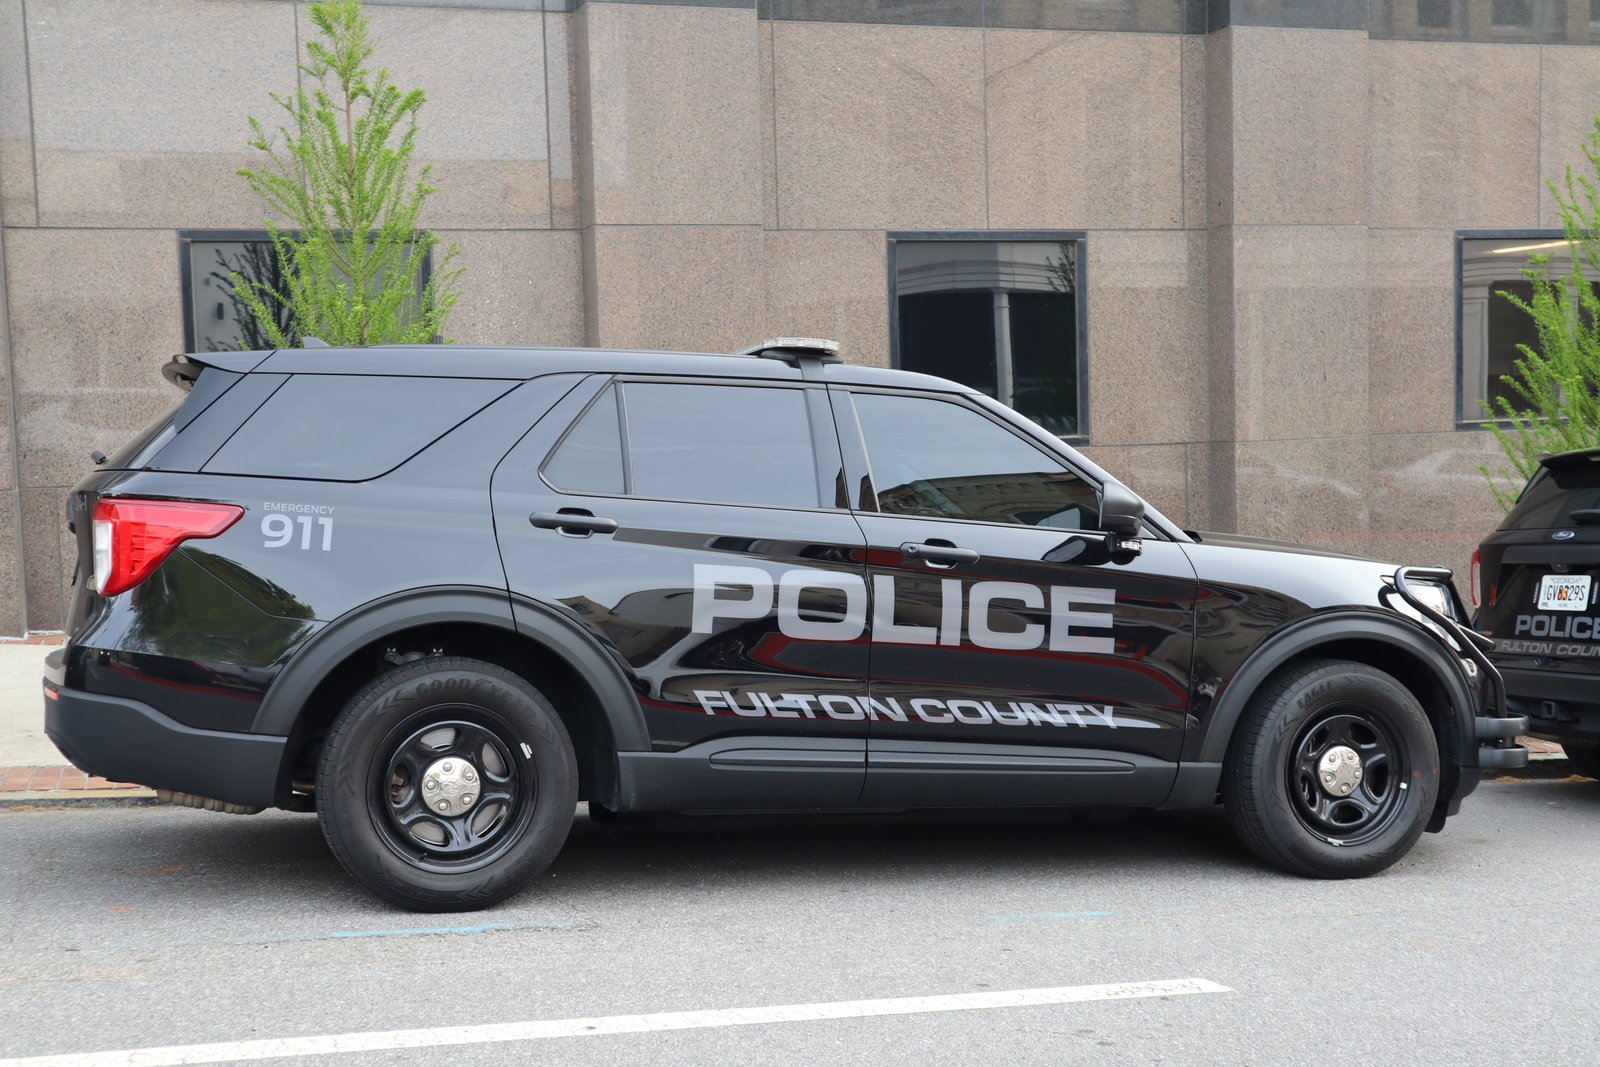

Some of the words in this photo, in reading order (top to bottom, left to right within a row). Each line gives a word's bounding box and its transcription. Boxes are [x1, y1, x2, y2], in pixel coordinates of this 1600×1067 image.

[263, 502, 335, 515] EMERGENCY
[261, 513, 333, 551] 911
[1546, 584, 1586, 601] GV8329S
[691, 563, 1116, 654] POLICE
[1501, 641, 1553, 654] FULTON
[693, 690, 908, 722] FULTON
[909, 698, 1118, 729] COUNTY
